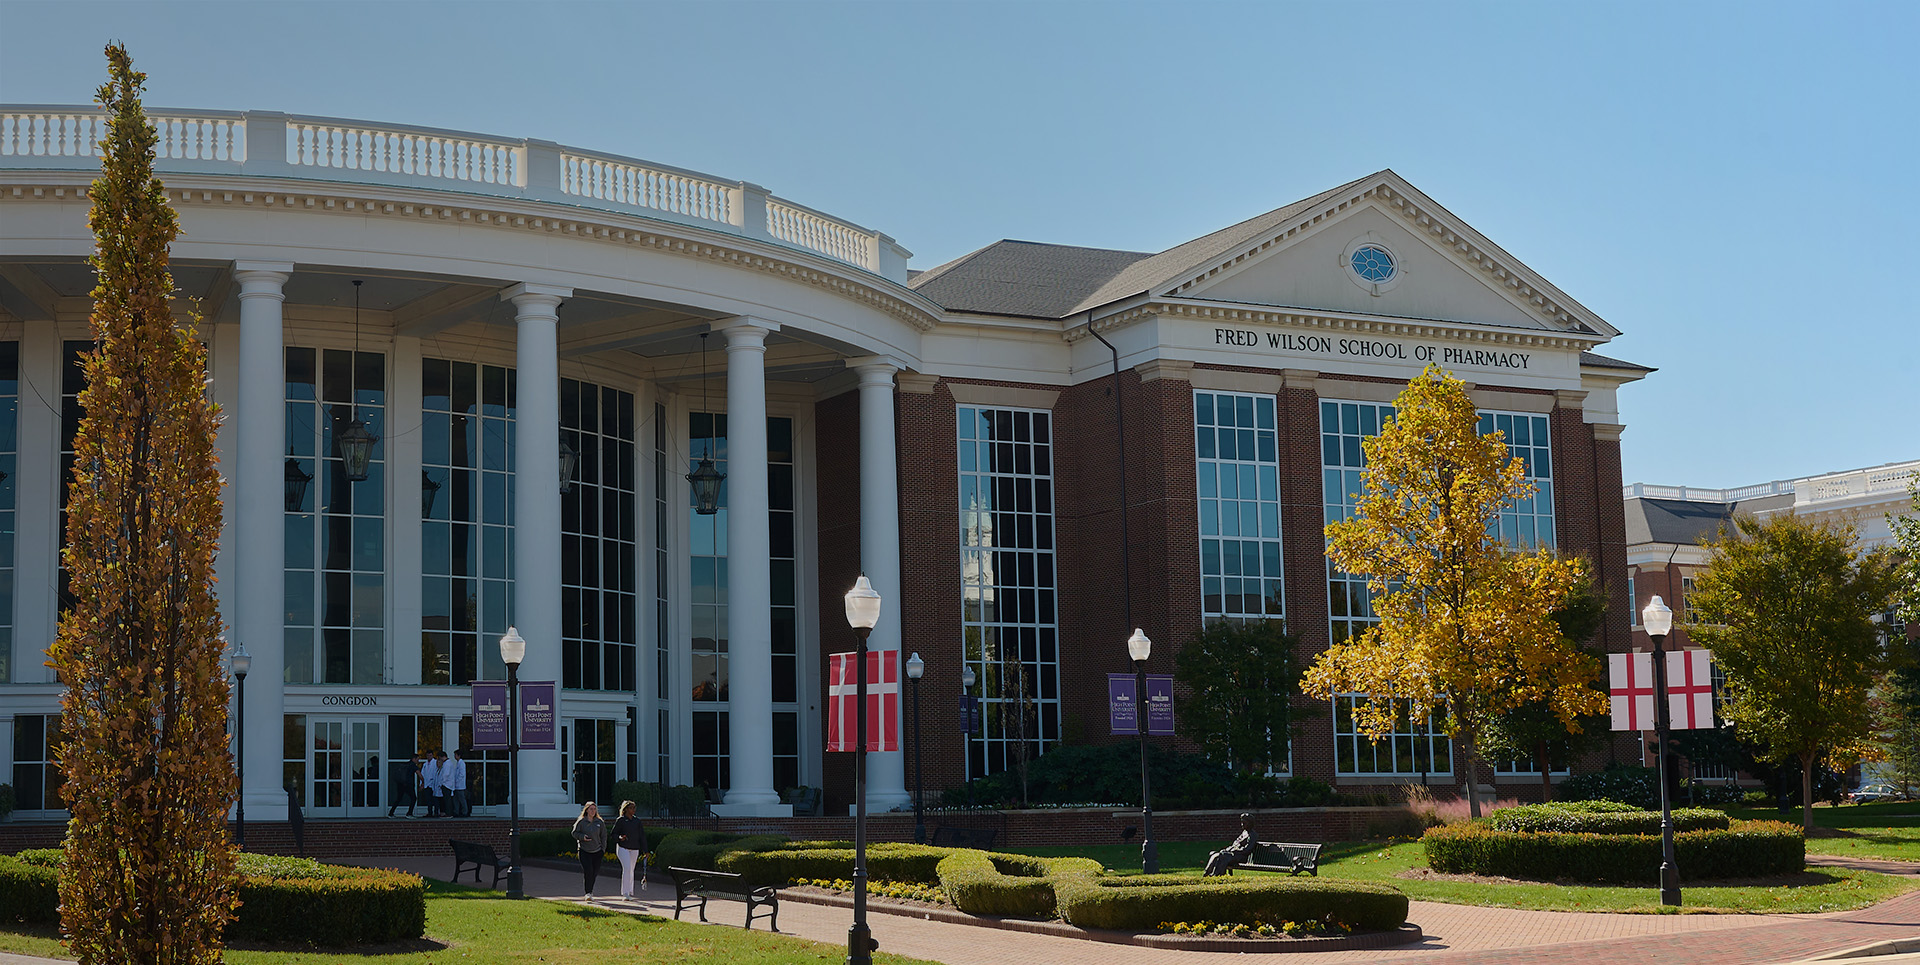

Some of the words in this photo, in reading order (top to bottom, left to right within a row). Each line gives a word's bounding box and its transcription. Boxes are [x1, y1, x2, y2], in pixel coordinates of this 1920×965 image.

[1214, 328, 1258, 347] FRED
[1266, 332, 1331, 353] WILSON
[1339, 338, 1407, 359] SCHOOL
[1415, 345, 1436, 361] OF
[1443, 347, 1530, 369] PHARMACY
[322, 696, 377, 706] CONGDON
